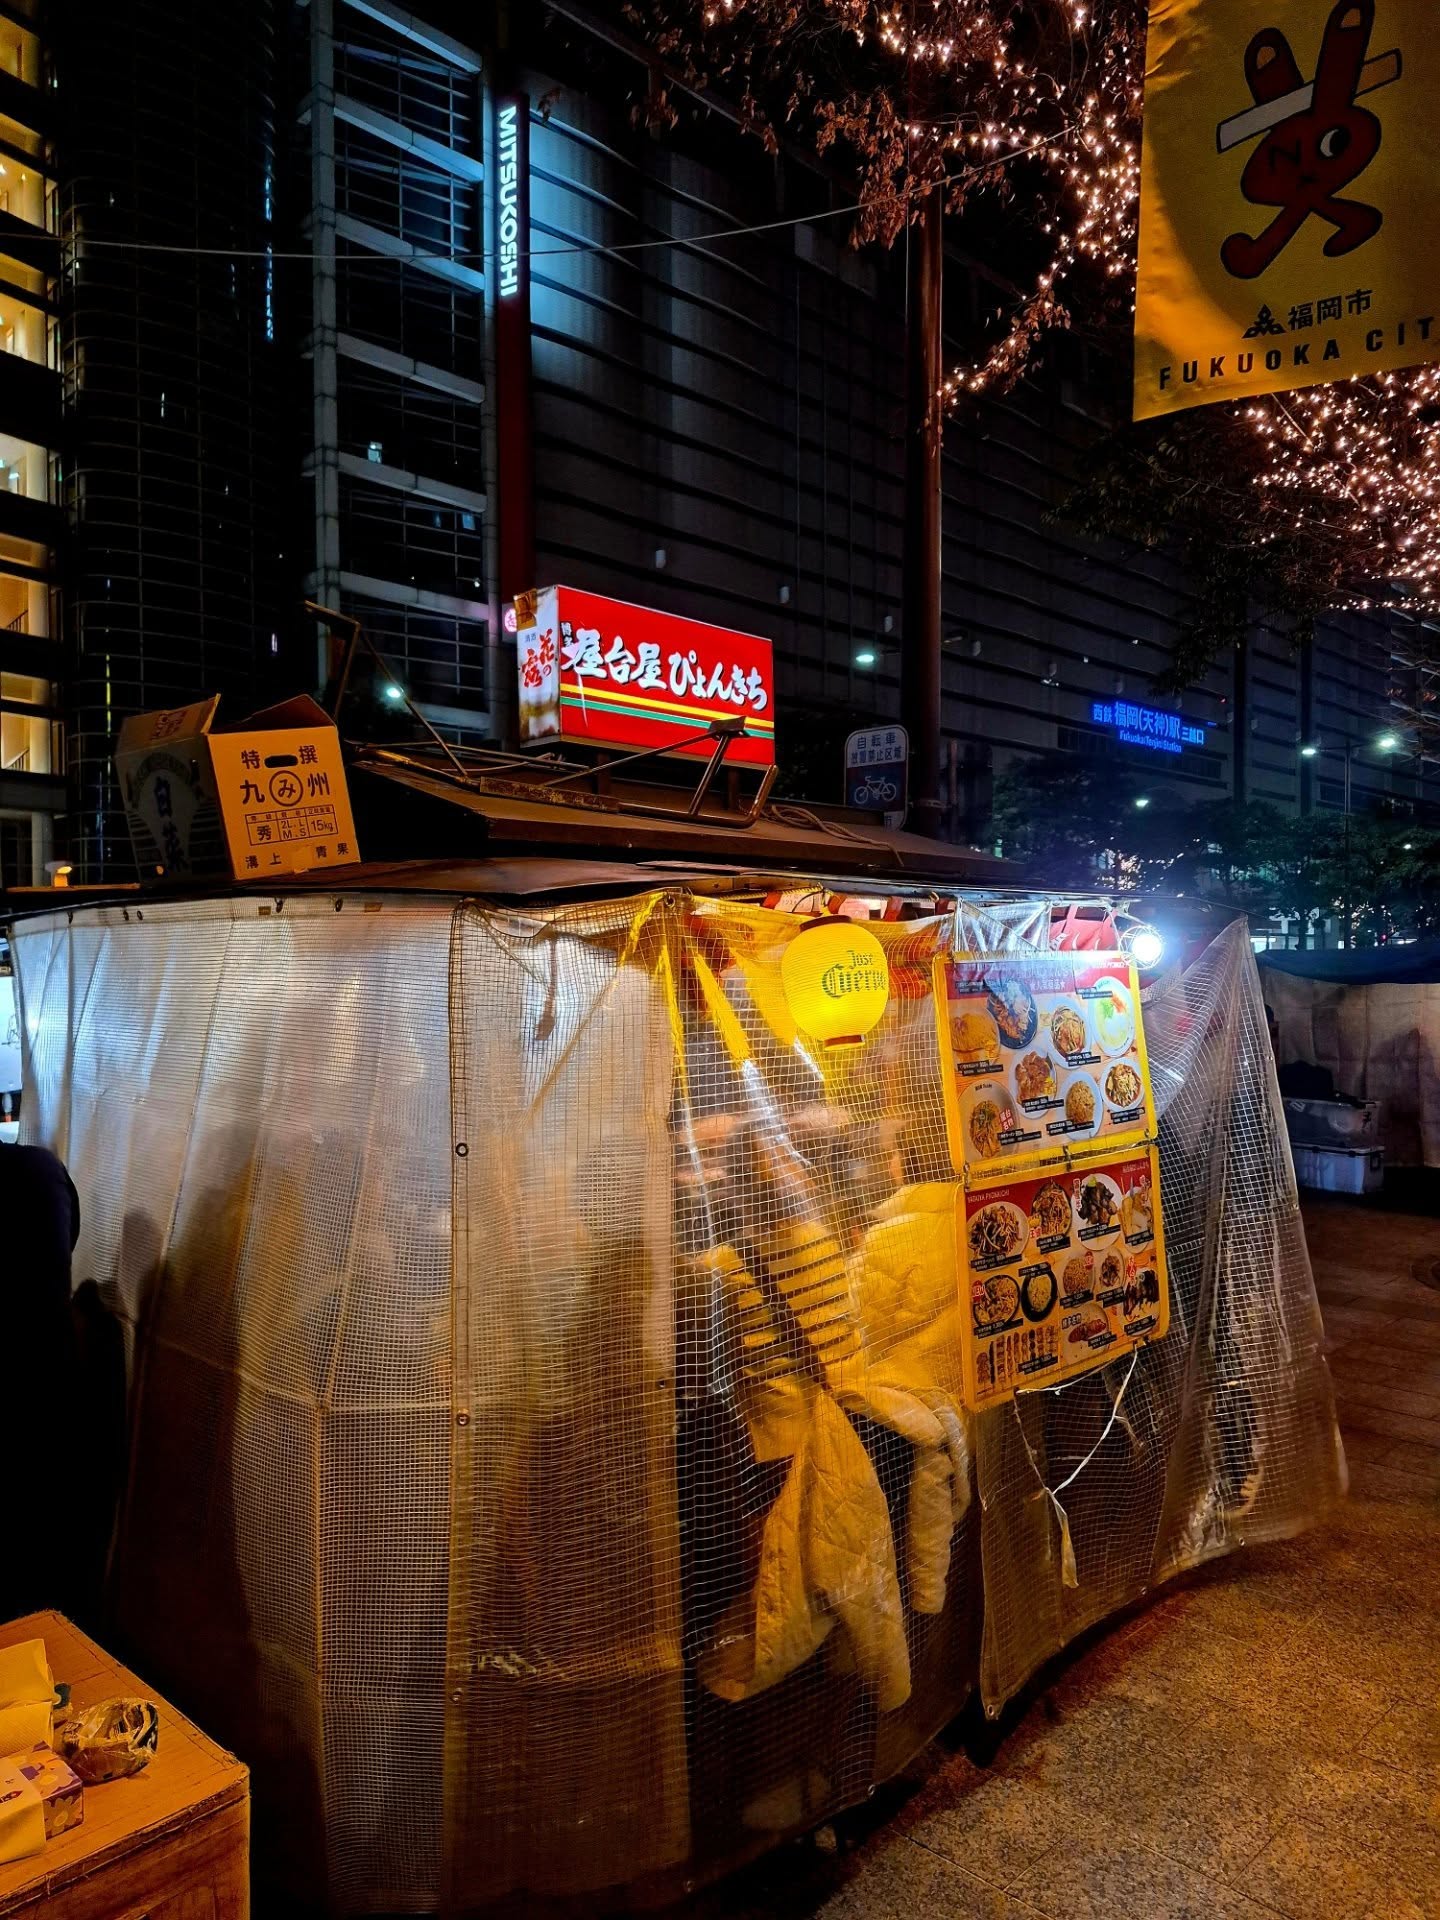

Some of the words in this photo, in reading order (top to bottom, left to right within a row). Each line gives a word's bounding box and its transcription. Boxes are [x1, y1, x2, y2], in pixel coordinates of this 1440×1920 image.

[500, 106, 518, 297] MITSUKOSHI
[1287, 288, 1373, 331] 福岡市
[1159, 339, 1340, 390] FUKUOKA
[1366, 316, 1435, 352] CIT
[561, 627, 768, 711] 屋台屋ぴょんきち
[1093, 703, 1112, 723] 西鉄
[857, 732, 896, 750] 自転車
[257, 825, 272, 841] 秀
[311, 820, 334, 833] 15kg
